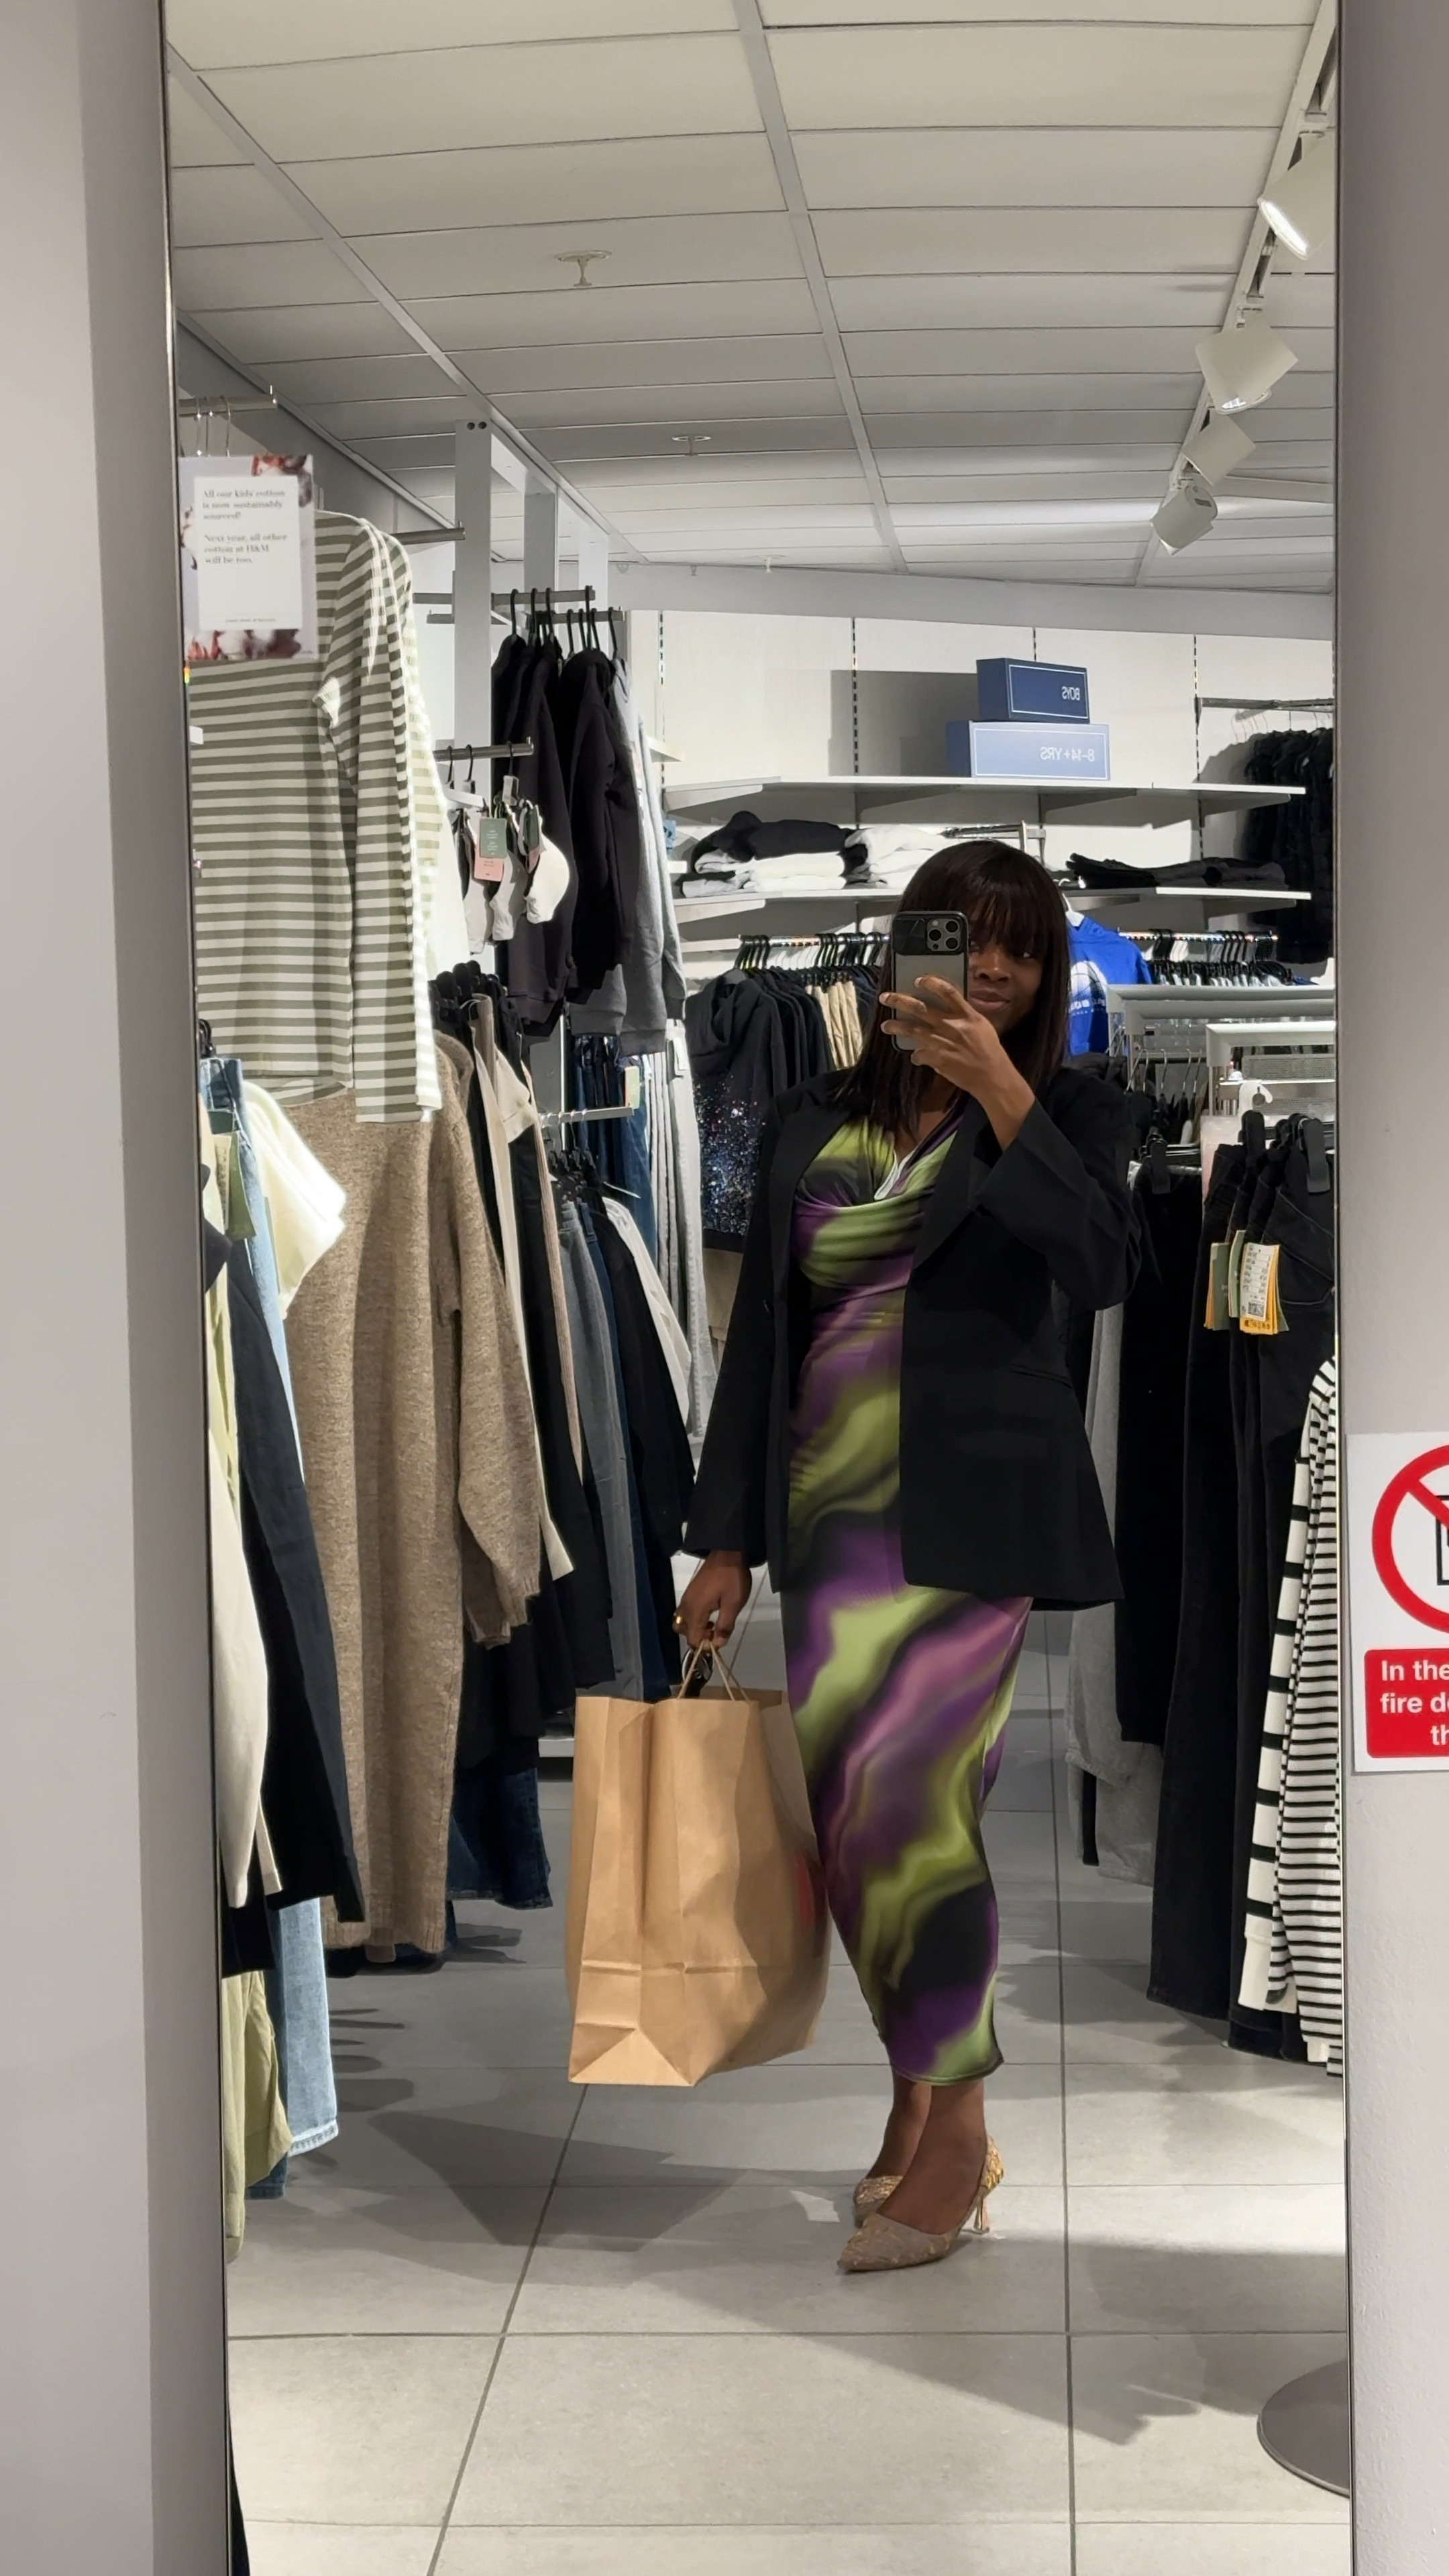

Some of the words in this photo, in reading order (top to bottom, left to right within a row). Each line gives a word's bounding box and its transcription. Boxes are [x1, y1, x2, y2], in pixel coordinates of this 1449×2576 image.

[203, 489, 215, 498] All
[233, 499, 282, 509] sustainably
[246, 544, 269, 552] H&M
[1381, 1660, 1404, 1681] In
[1412, 1660, 1449, 1680] the
[1380, 1693, 1423, 1713] fire
[1430, 1692, 1449, 1713] d
